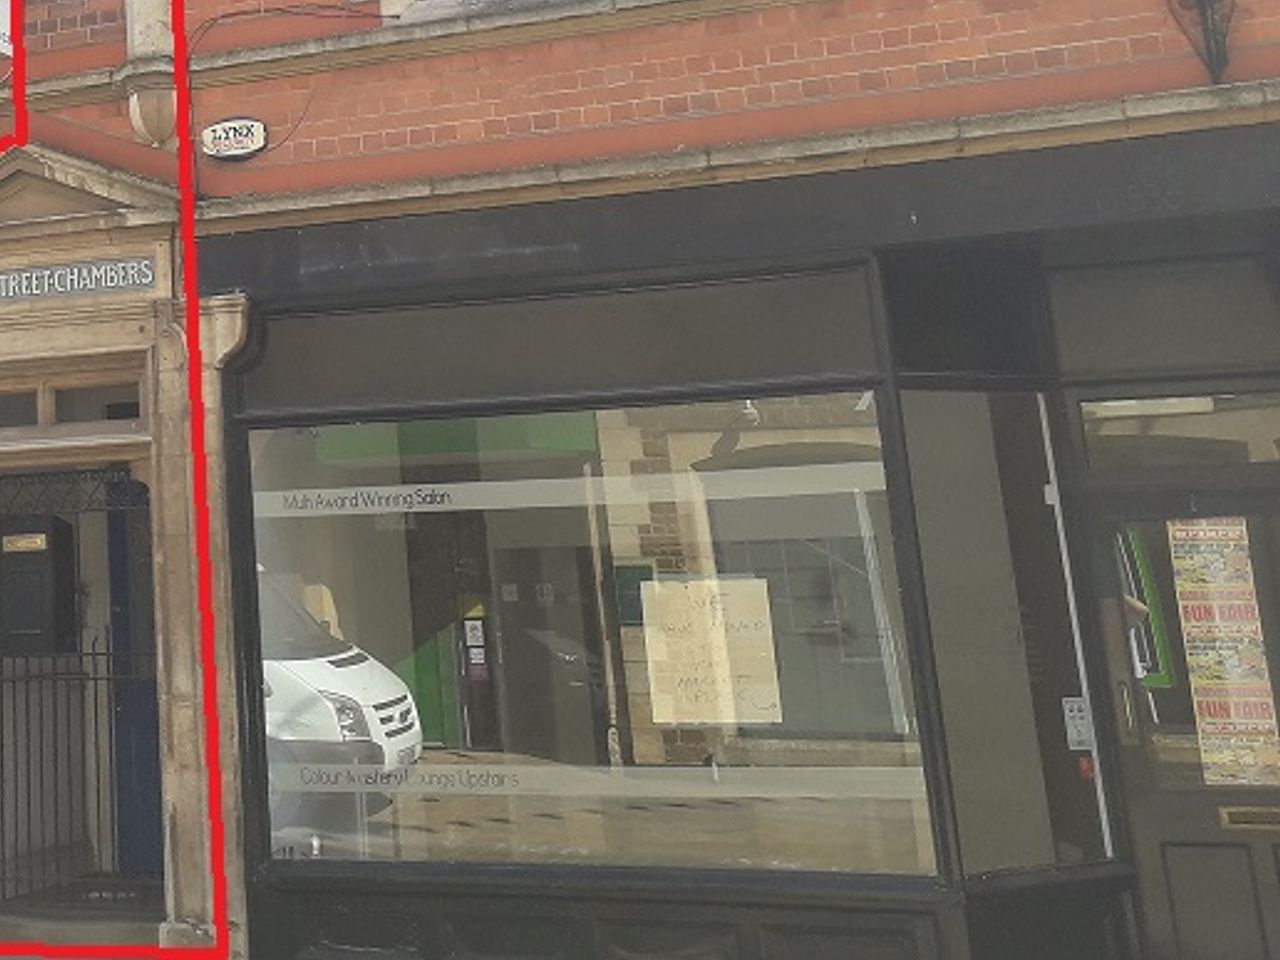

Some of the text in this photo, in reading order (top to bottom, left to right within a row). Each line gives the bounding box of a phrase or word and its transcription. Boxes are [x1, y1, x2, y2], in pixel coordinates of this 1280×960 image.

[210, 124, 255, 141] LYNX
[54, 260, 153, 292] CHAMBERS
[317, 491, 358, 510] Award
[360, 491, 413, 510] Winning
[415, 488, 453, 506] Salon
[1197, 700, 1232, 720] FUN
[300, 767, 341, 785] Colour
[404, 769, 455, 789] Lunge
[459, 770, 519, 787] Upstairs
